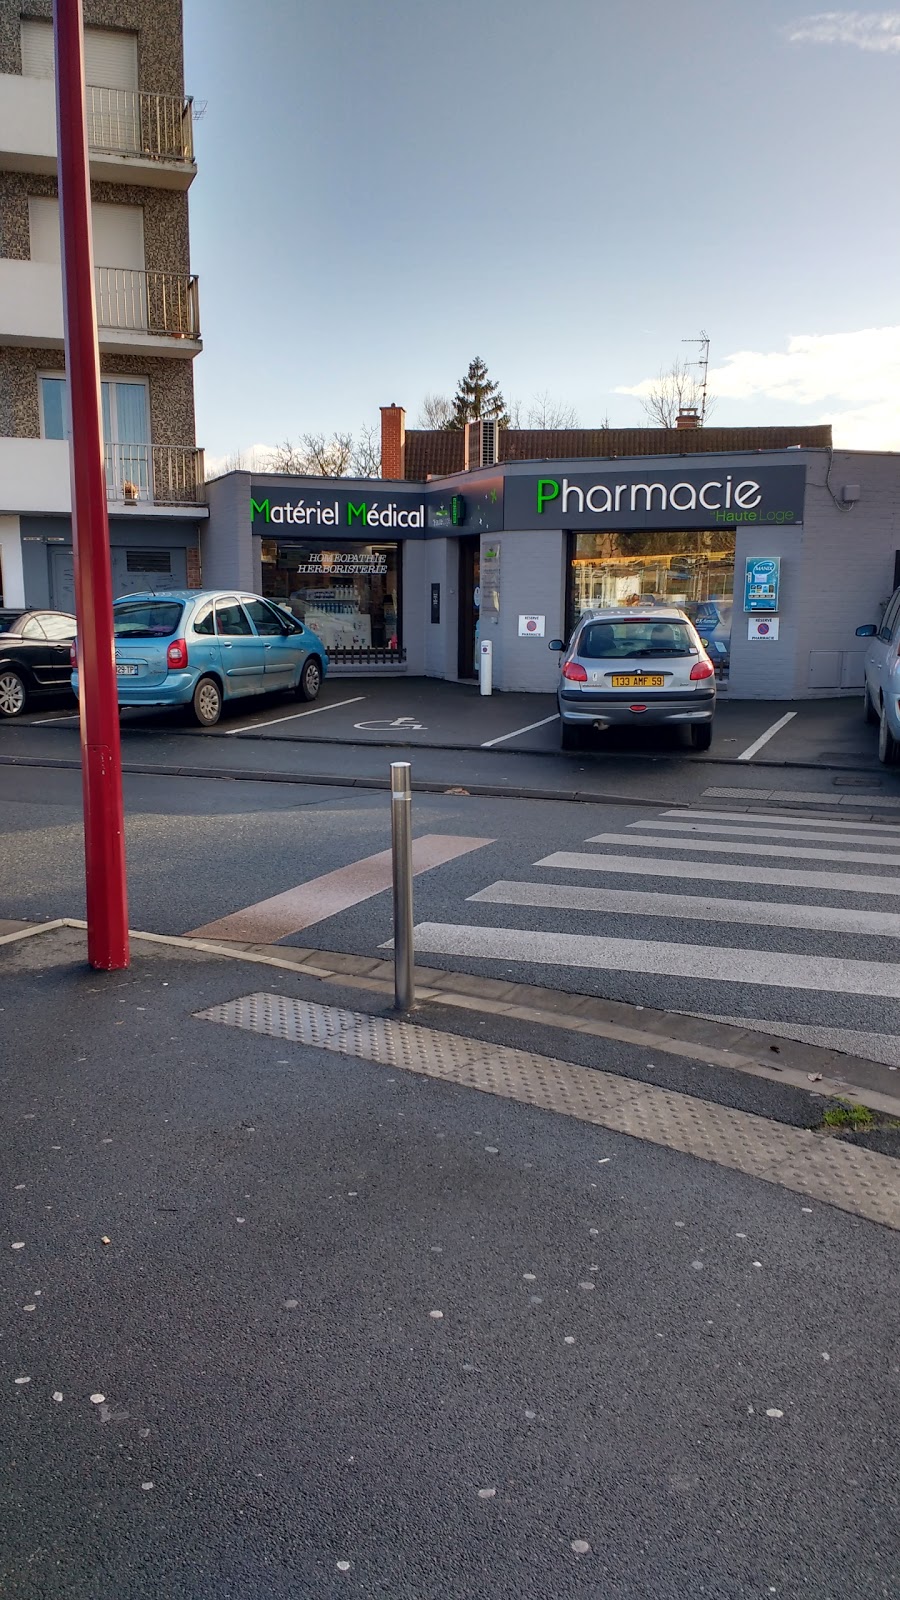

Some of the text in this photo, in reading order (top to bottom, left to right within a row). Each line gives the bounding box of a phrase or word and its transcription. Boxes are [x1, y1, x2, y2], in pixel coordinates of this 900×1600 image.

[537, 475, 762, 513] Pharmacie
[250, 498, 339, 525] Matériel
[347, 502, 425, 528] Médical
[715, 509, 794, 524] Haute Loge
[297, 564, 388, 574] HERBORISTERIE
[615, 677, 662, 686] 133 AMF 59
